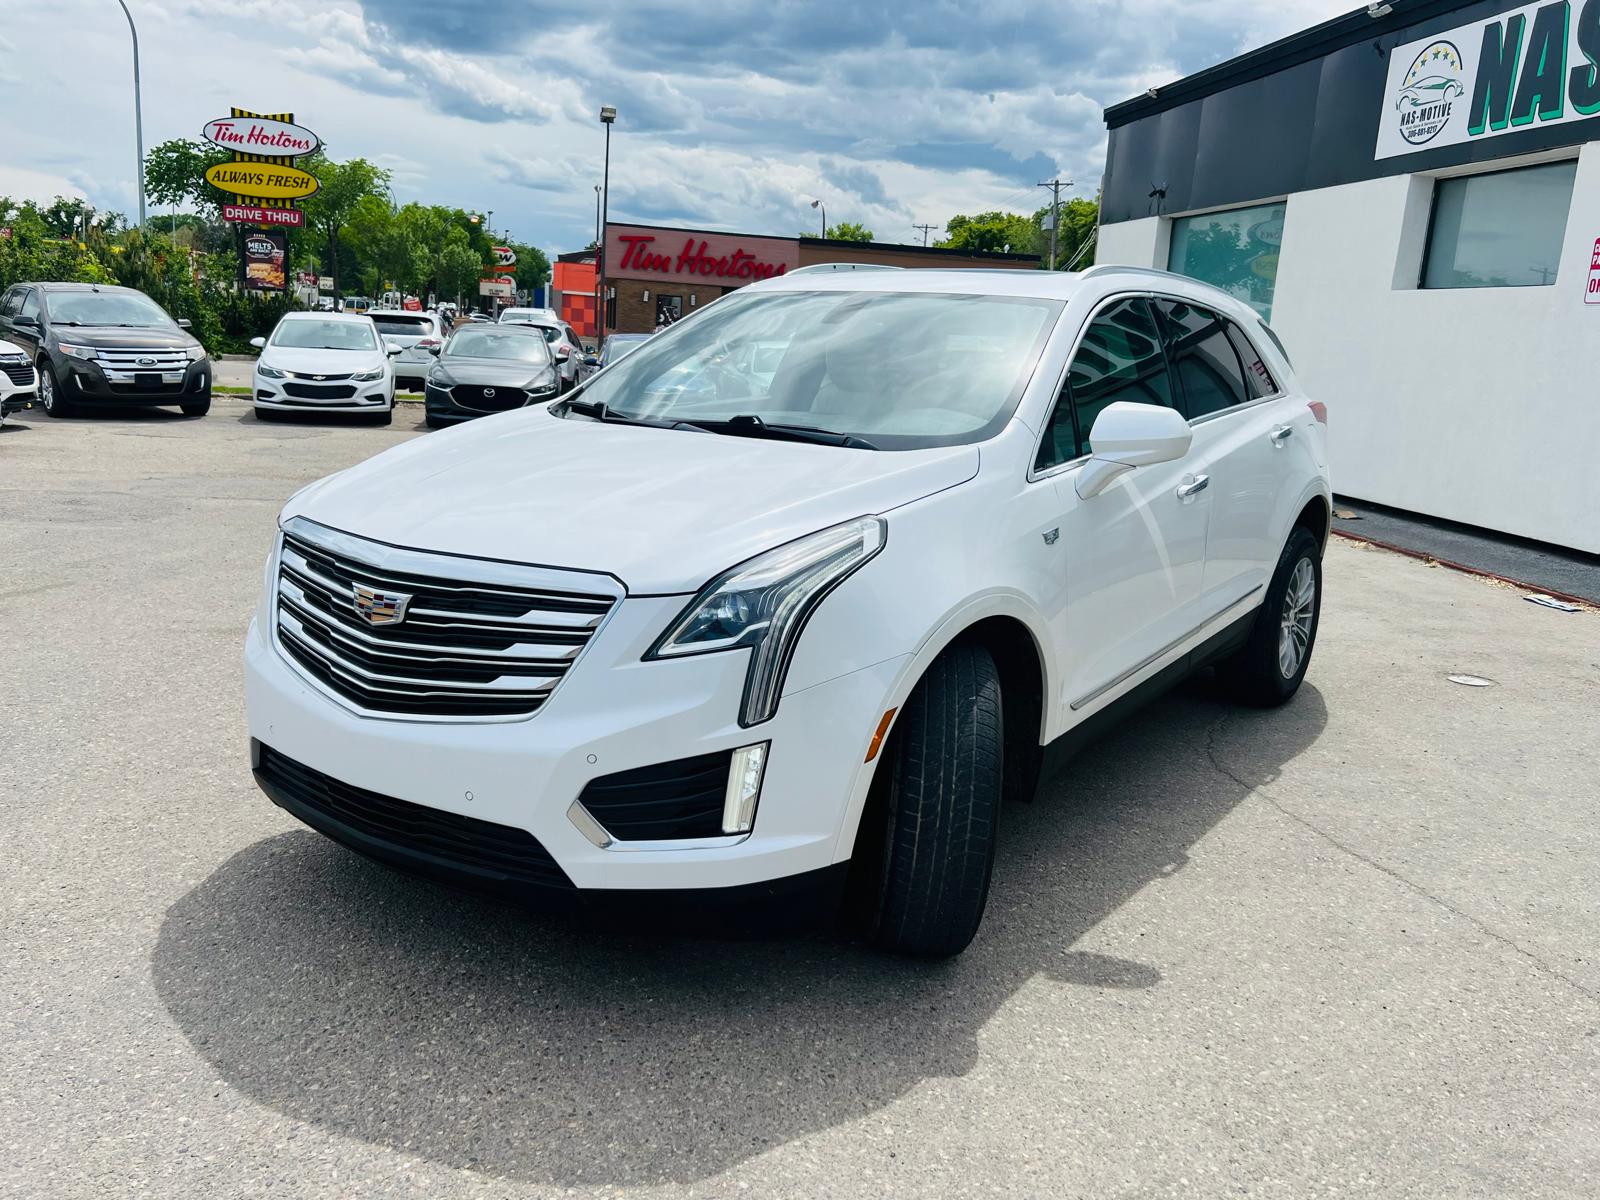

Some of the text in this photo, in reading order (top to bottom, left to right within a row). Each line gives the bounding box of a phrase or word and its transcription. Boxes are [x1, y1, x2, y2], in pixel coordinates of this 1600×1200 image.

[1400, 102, 1452, 127] NAS-MOTIVE
[212, 123, 310, 150] Tim Hortons
[211, 170, 311, 189] ALWAYS FRESH
[225, 207, 299, 224] DRIVE THRU
[248, 242, 272, 250] MELTS
[618, 235, 786, 279] Tim Hortons
